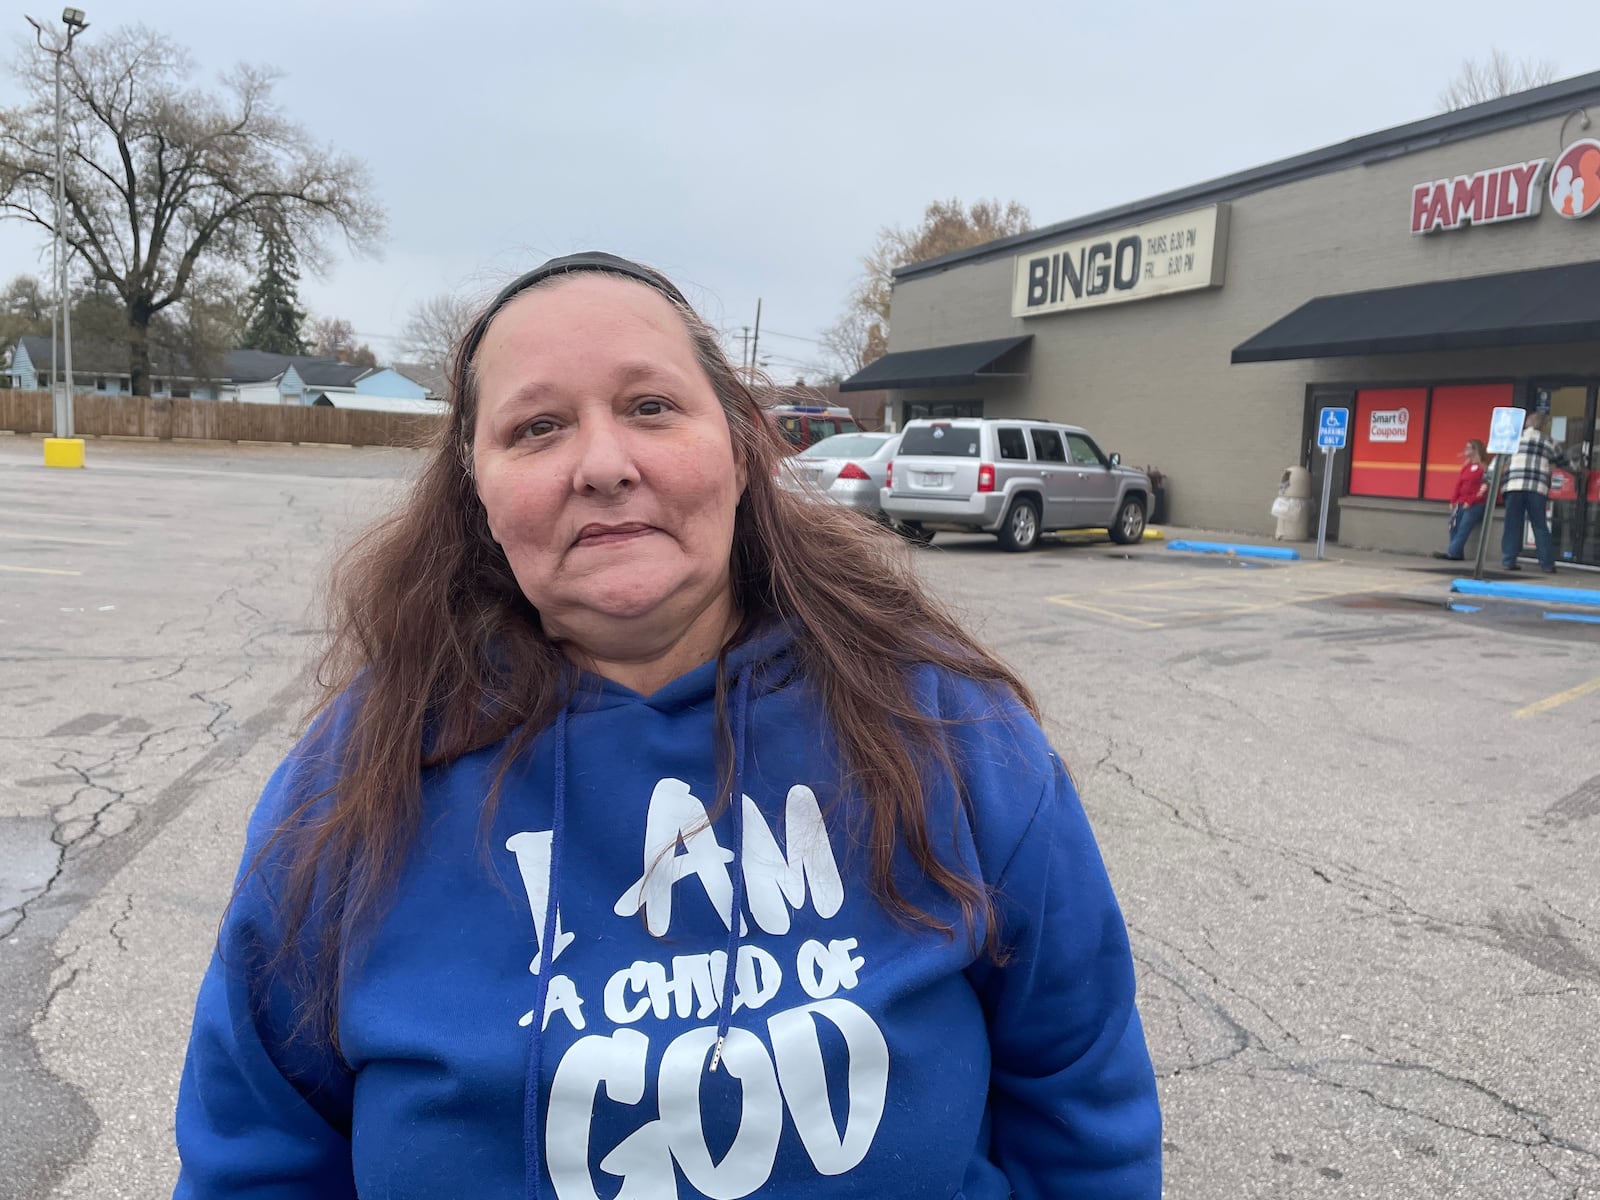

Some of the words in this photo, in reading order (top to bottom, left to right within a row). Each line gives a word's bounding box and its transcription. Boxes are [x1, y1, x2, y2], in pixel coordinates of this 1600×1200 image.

[1411, 161, 1542, 234] FAMILY
[1186, 227, 1197, 249] PM
[1027, 234, 1142, 307] BINGO
[1183, 252, 1195, 273] PM
[1372, 412, 1396, 424] Smart
[1320, 427, 1345, 436] PARKING
[1324, 436, 1340, 445] ONLY
[1371, 425, 1406, 438] Coupons
[505, 830, 575, 975] I
[614, 777, 844, 938] AM
[518, 974, 586, 1032] A
[604, 944, 782, 1024] CHILD
[797, 937, 865, 999] OF
[546, 998, 890, 1200] GOD
